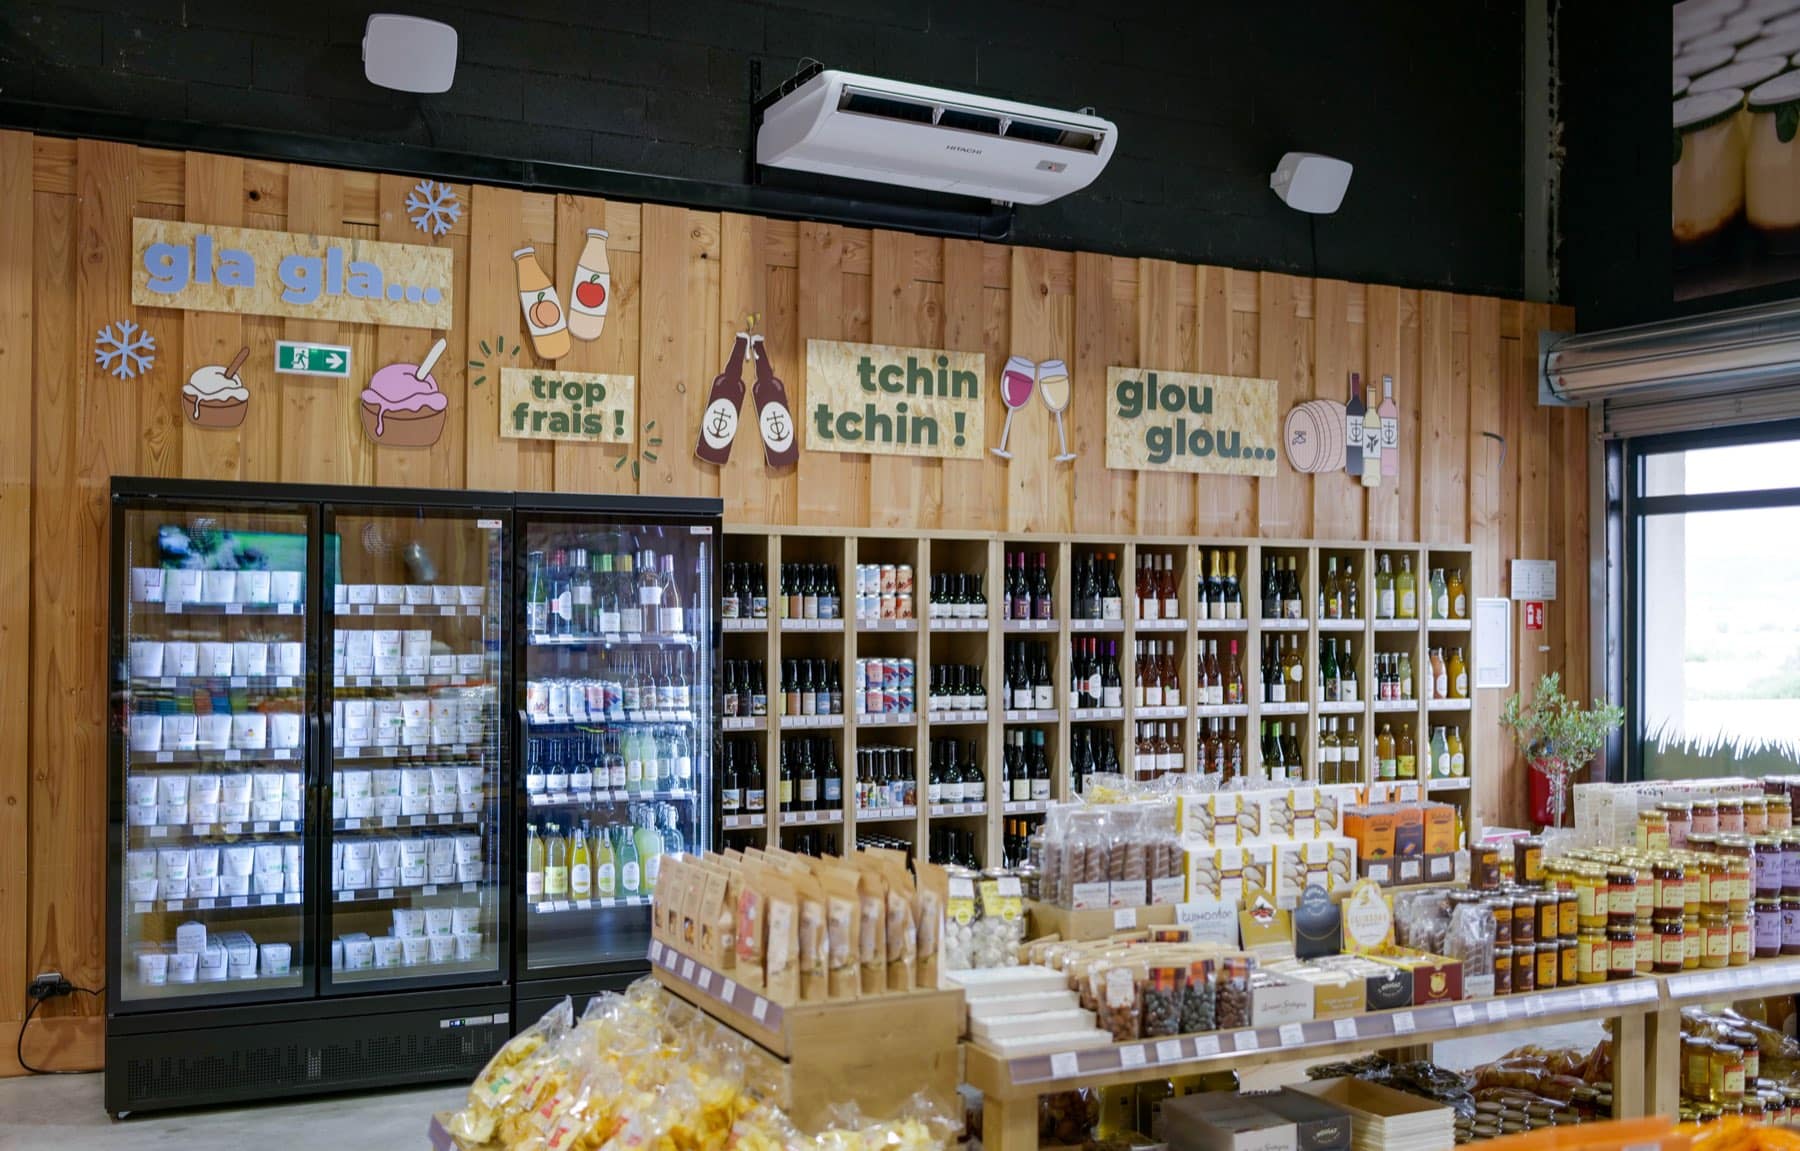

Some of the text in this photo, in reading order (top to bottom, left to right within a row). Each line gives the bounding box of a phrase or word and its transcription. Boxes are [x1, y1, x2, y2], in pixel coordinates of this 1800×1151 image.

[143, 234, 442, 305] gla gla...
[531, 375, 607, 407] trop
[856, 355, 979, 399] tchin
[1116, 373, 1214, 419] glou
[512, 402, 626, 437] frais !
[813, 402, 966, 447] tchin !
[1145, 418, 1277, 465] glou...
